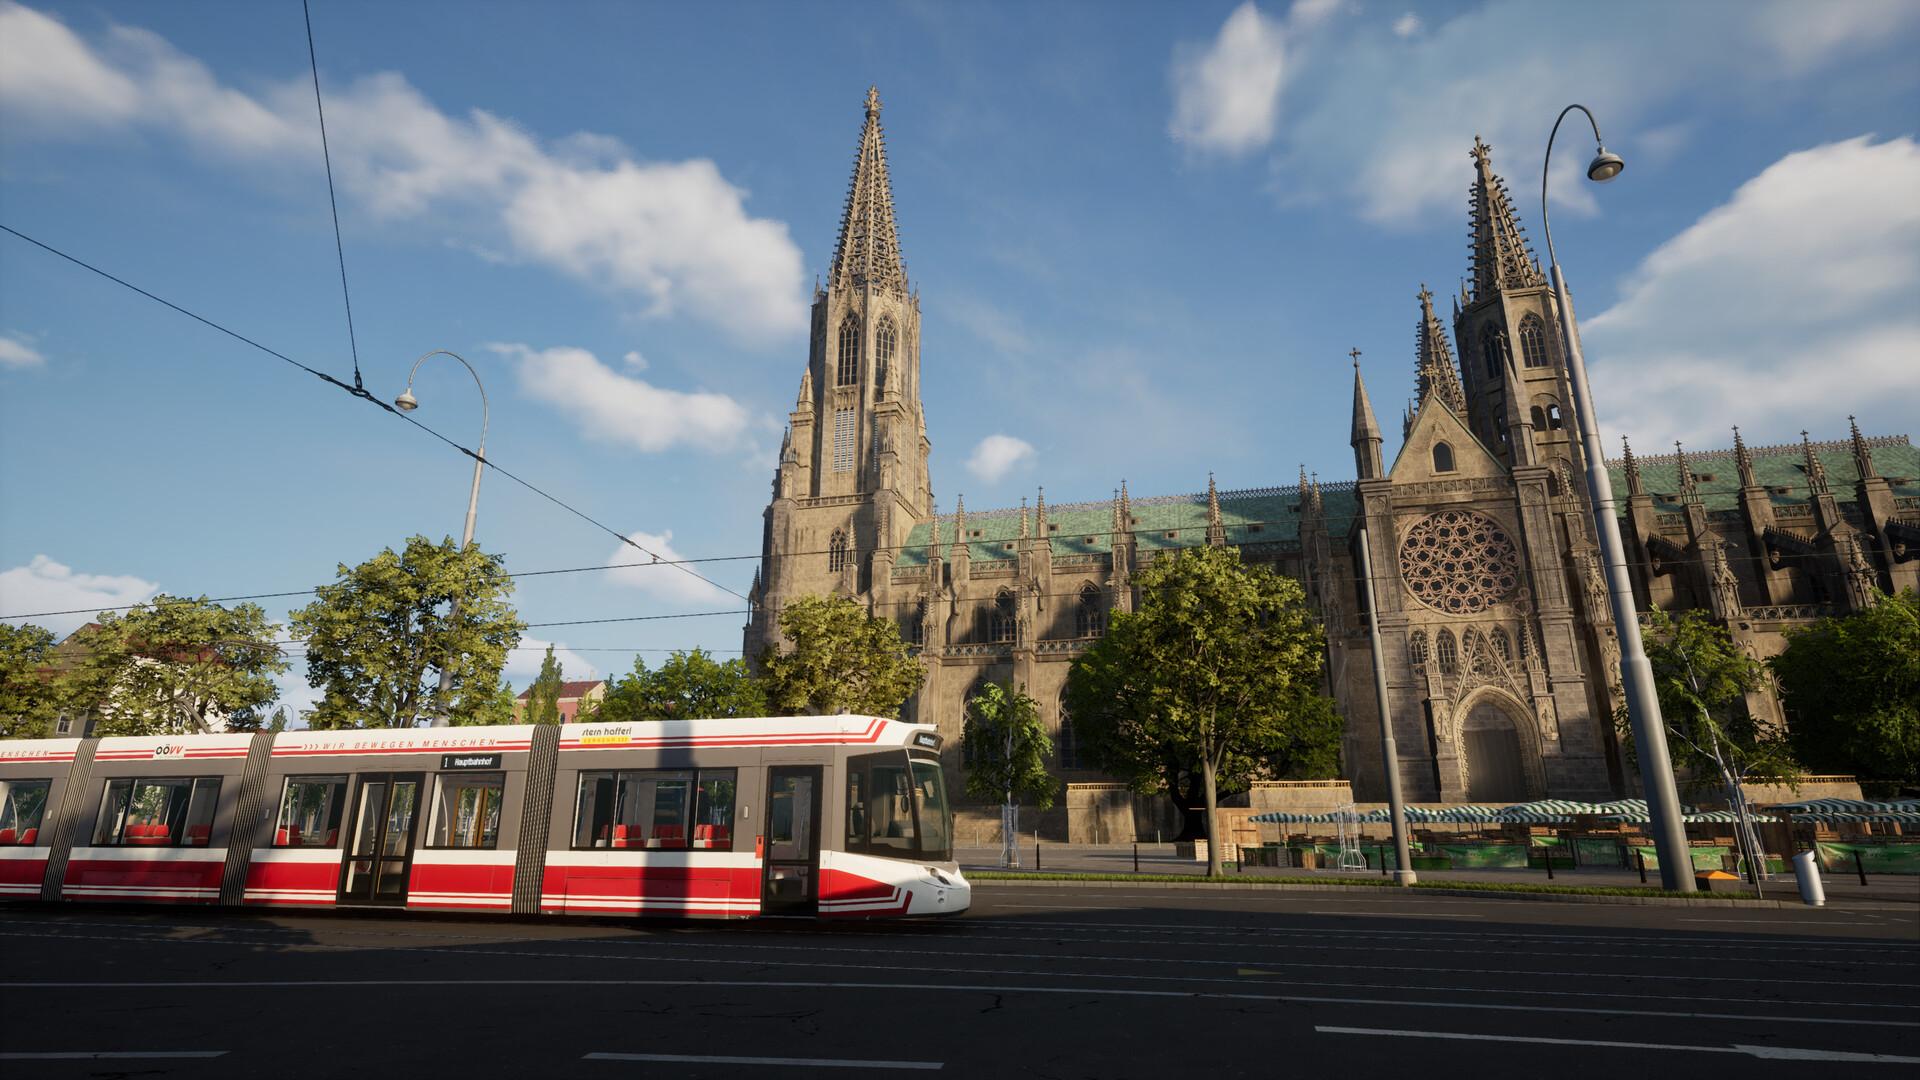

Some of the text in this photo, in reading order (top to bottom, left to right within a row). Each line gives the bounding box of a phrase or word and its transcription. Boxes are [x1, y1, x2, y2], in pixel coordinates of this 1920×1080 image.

[582, 728, 602, 736] stern
[156, 743, 184, 755] OÖVV
[323, 738, 496, 750] WIR BEWEGEN MENSCHEN
[454, 757, 493, 767] Hauptbahnhof
